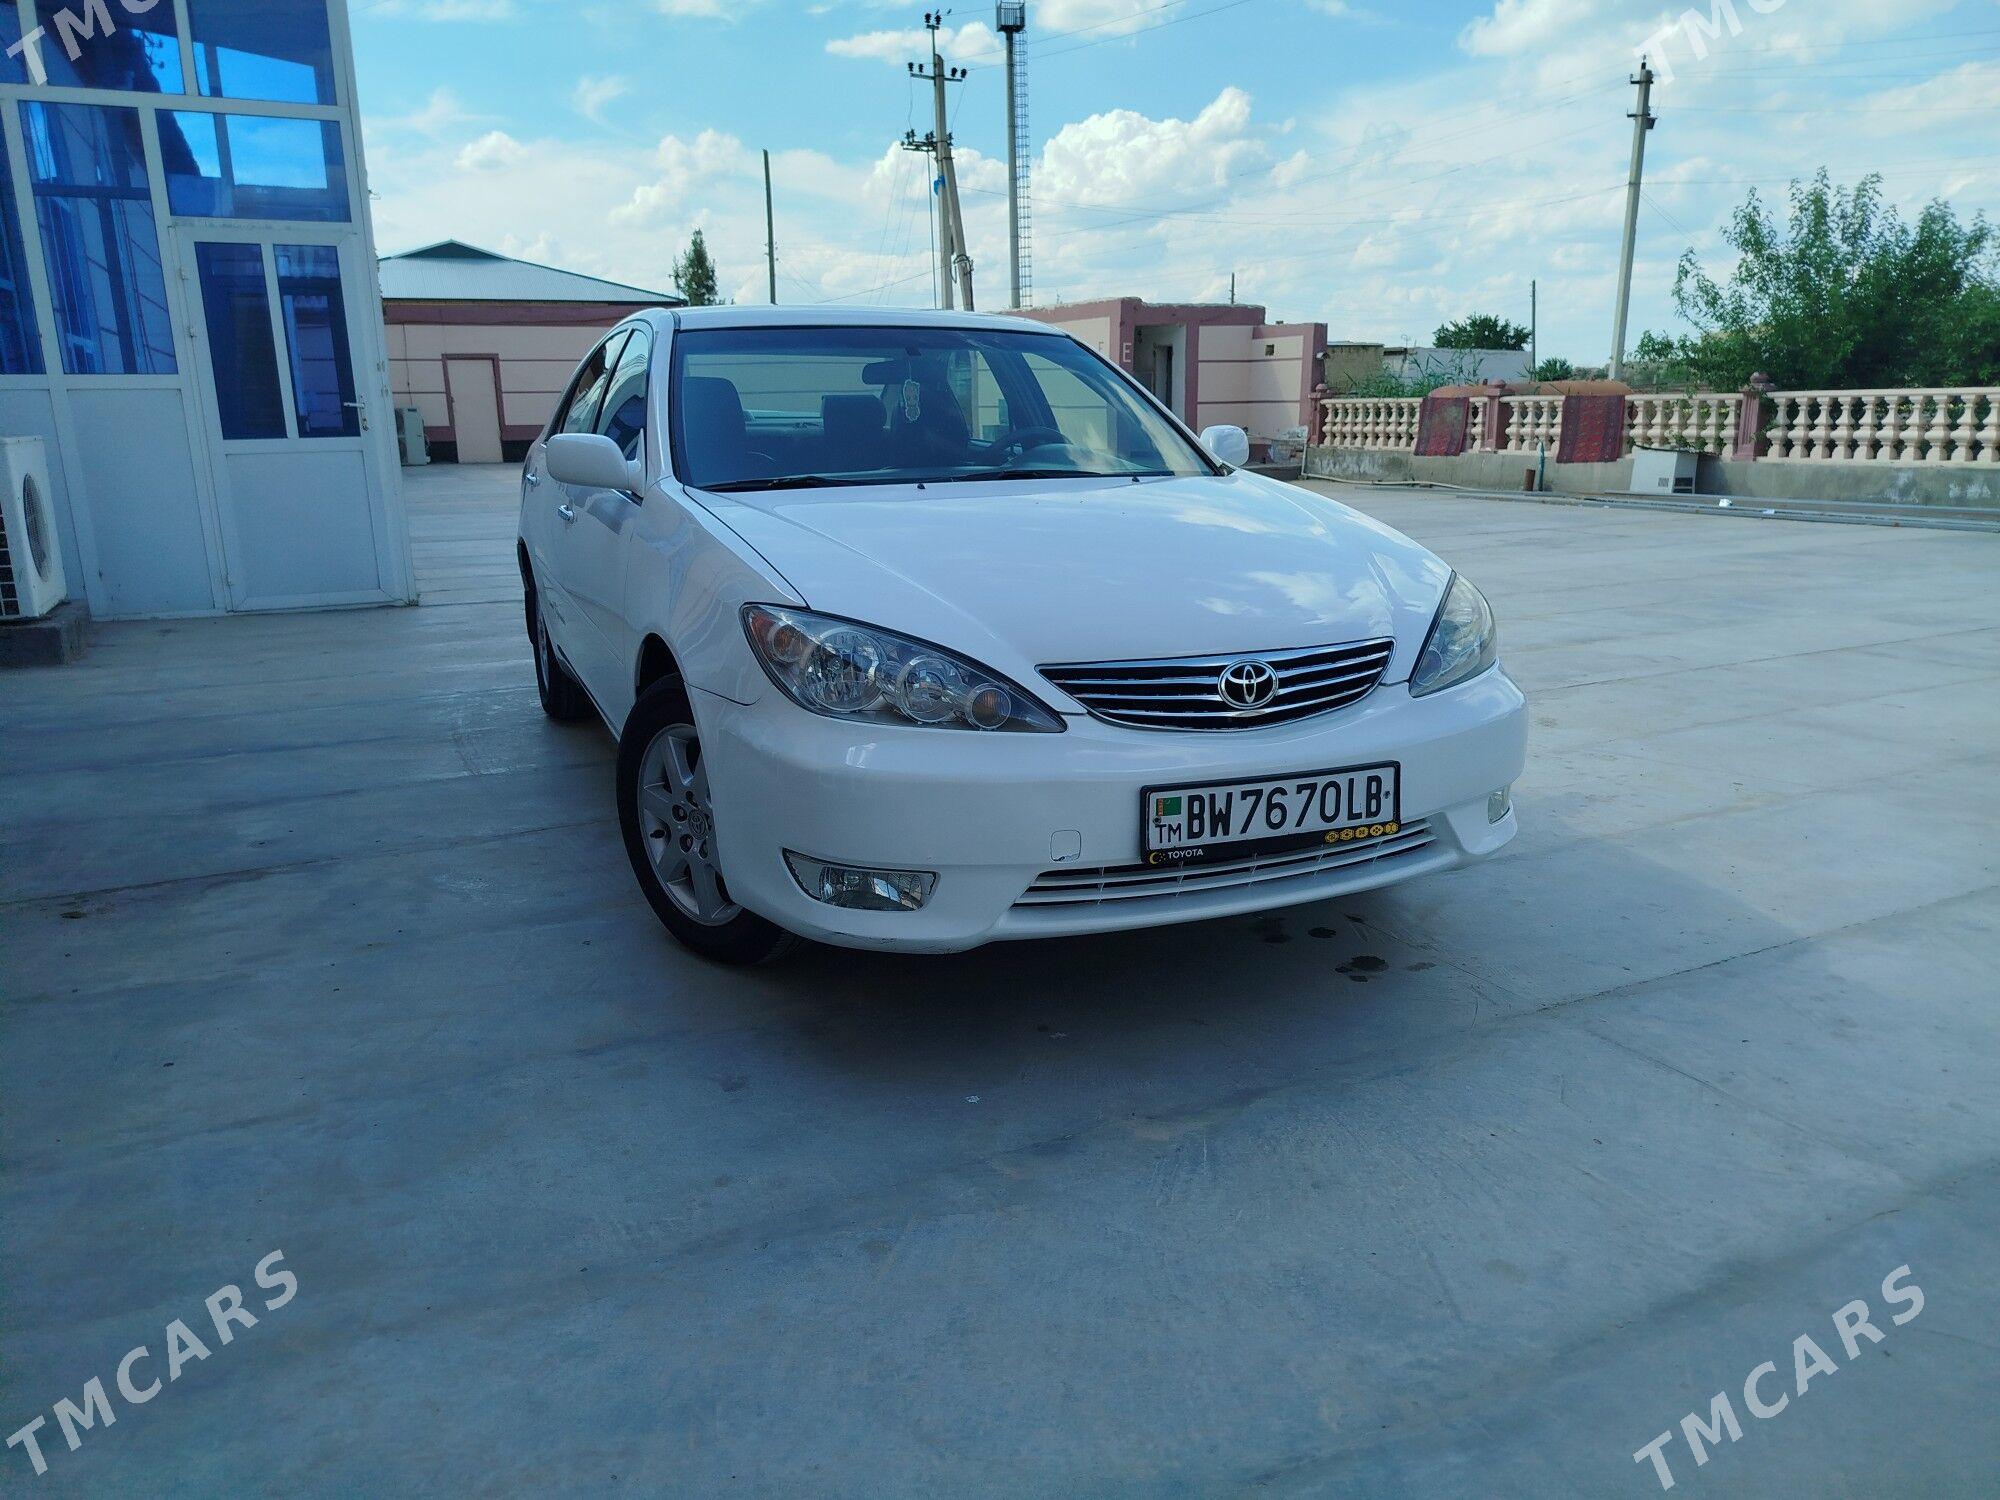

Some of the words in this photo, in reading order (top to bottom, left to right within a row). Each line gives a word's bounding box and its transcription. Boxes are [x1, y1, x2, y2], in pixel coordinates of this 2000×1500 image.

[1187, 774, 1383, 840] BW7670LB
[1154, 822, 1182, 844] TM
[1167, 848, 1204, 859] TOYOTA
